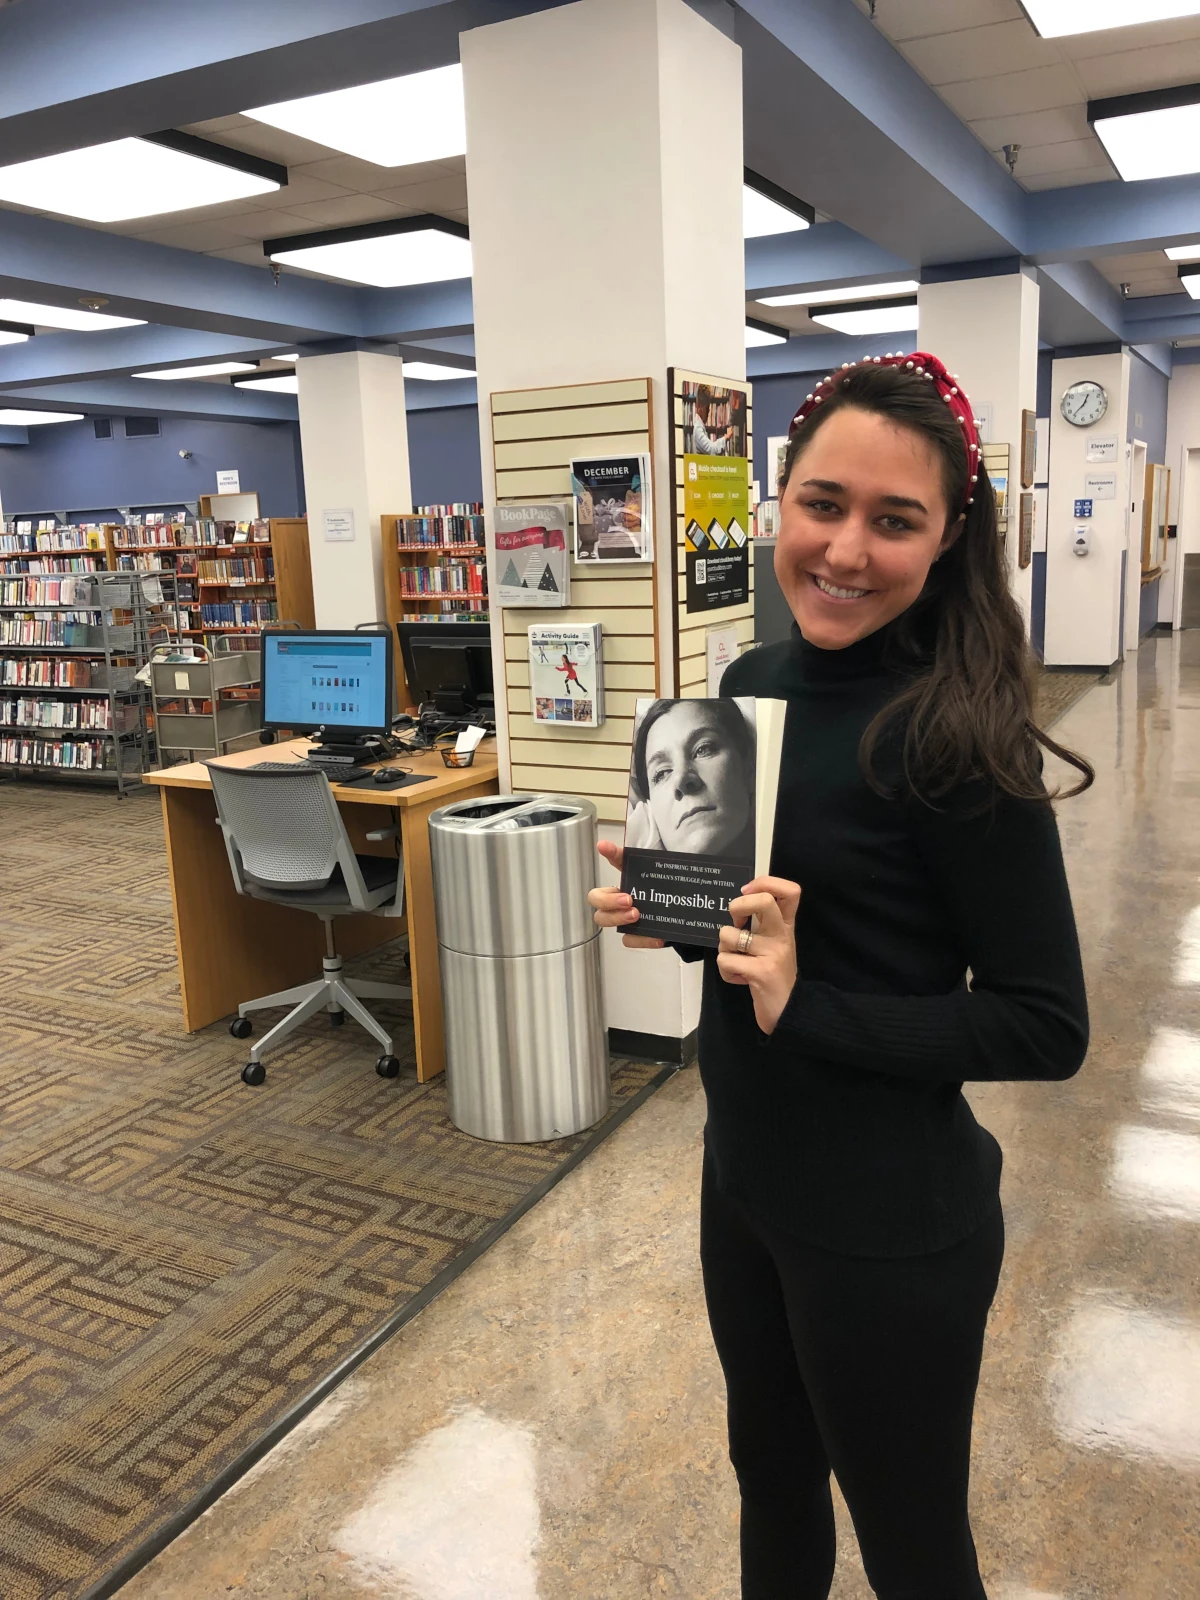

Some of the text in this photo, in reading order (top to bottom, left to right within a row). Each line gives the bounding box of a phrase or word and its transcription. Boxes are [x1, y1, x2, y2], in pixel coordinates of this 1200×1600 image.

[1090, 442, 1115, 450] Elevator
[583, 466, 630, 477] DECEMBER
[499, 507, 557, 522] BookPage
[499, 532, 544, 547] Gifts for everyone
[541, 632, 562, 640] Activity
[663, 863, 689, 871] INSPIRING
[690, 865, 703, 873] TRUE
[650, 872, 674, 880] WOMAN'S
[674, 875, 700, 884] STRUGGLE
[712, 880, 735, 888] WITHIN
[630, 886, 646, 901] An
[649, 888, 715, 910] Impossible
[640, 912, 655, 921] HAEL
[655, 915, 686, 925] SIDDOWAY
[696, 921, 715, 929] SONIA
